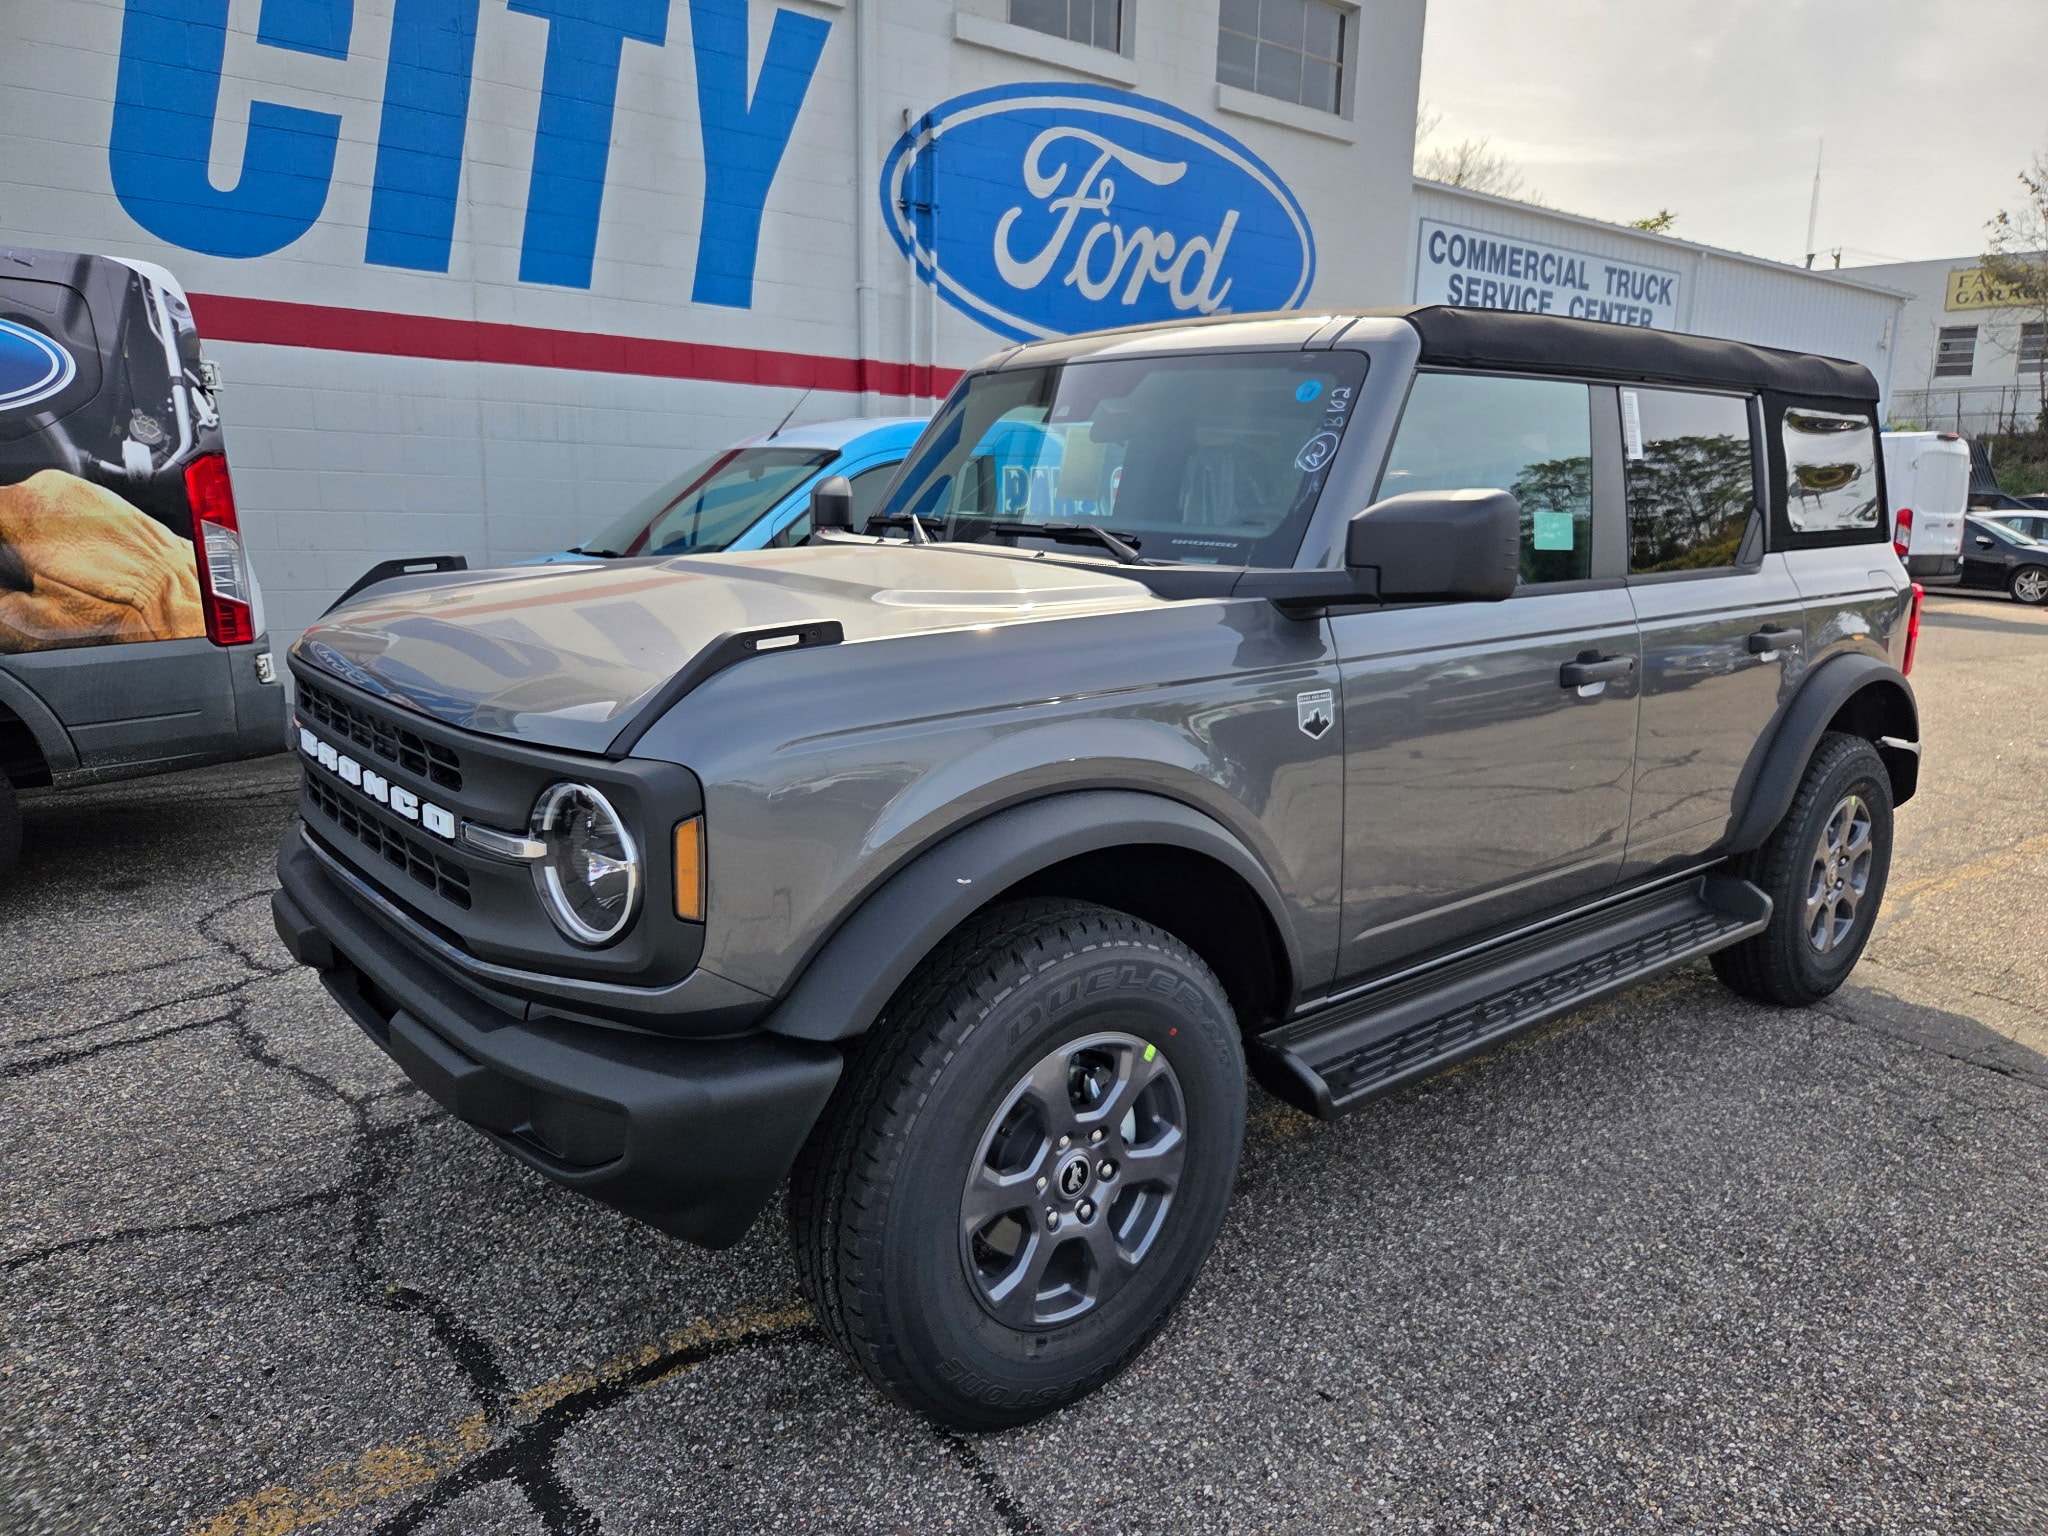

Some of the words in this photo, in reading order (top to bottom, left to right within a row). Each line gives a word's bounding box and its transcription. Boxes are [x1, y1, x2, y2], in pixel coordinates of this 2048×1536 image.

[109, 0, 832, 309] CITY
[994, 127, 1240, 314] Ford
[1428, 230, 1590, 291] COMMERCIAL
[1604, 265, 1673, 306] TRUCK
[1447, 273, 1554, 314] SERVICE
[1568, 295, 1654, 328] CENTER
[1171, 538, 1239, 549] BRONCO
[300, 727, 456, 839] BRONCO
[1006, 964, 1206, 1048] DUELER
